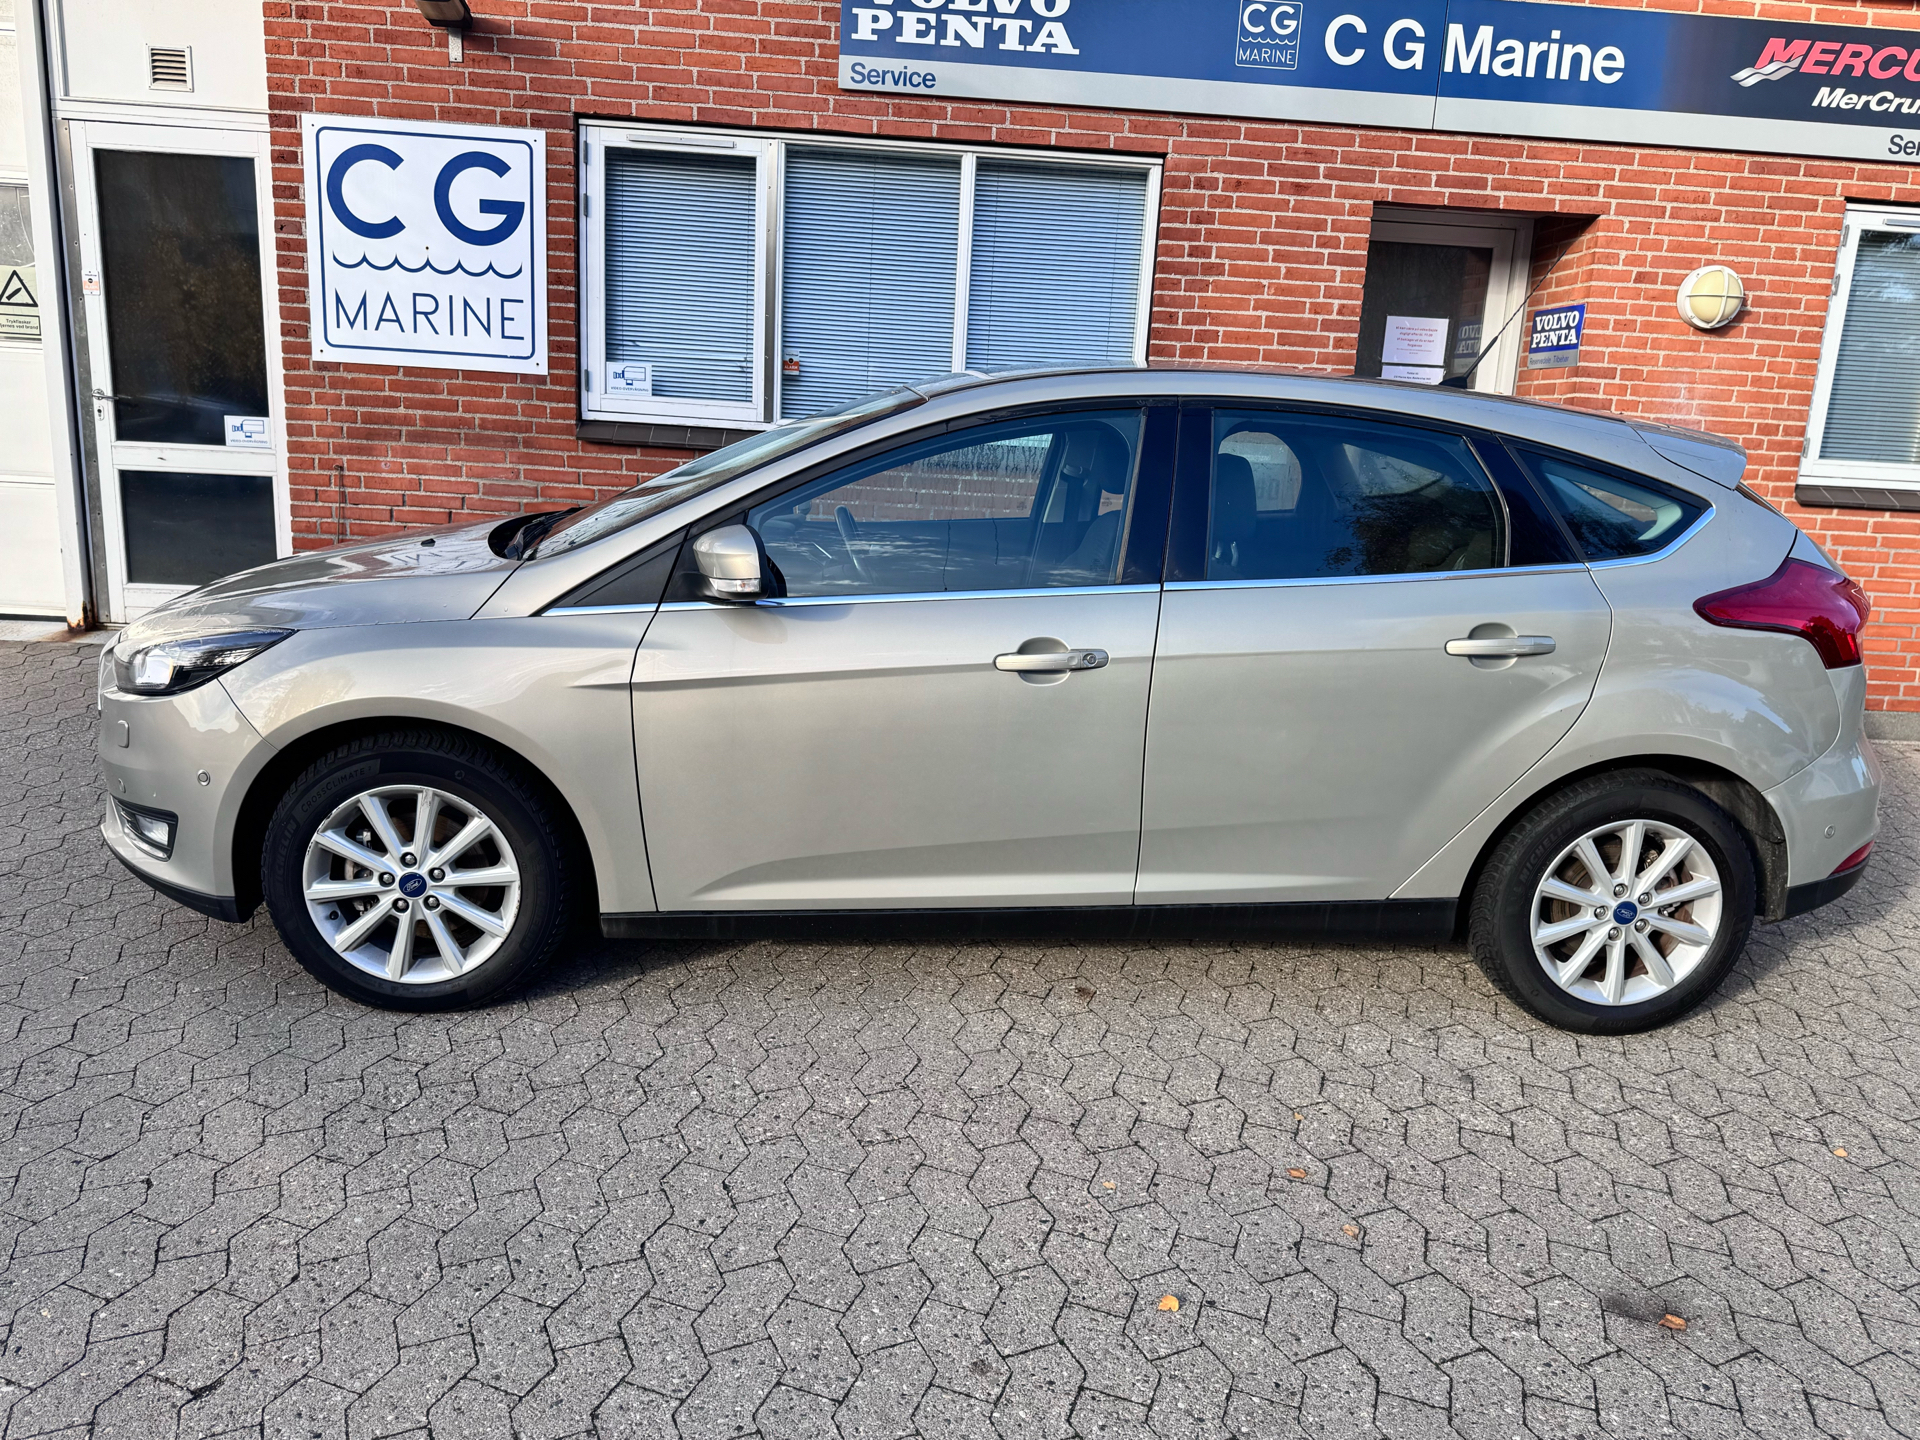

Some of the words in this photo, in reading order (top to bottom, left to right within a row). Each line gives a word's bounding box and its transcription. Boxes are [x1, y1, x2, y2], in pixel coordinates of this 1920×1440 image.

[851, 7, 1080, 55] PENTA
[1239, 47, 1295, 64] MARINE
[1443, 23, 1625, 85] Marine
[849, 62, 937, 89] Service
[334, 288, 525, 341] MARINE
[1535, 311, 1580, 331] VOLVO
[1531, 328, 1578, 348] PENTA
